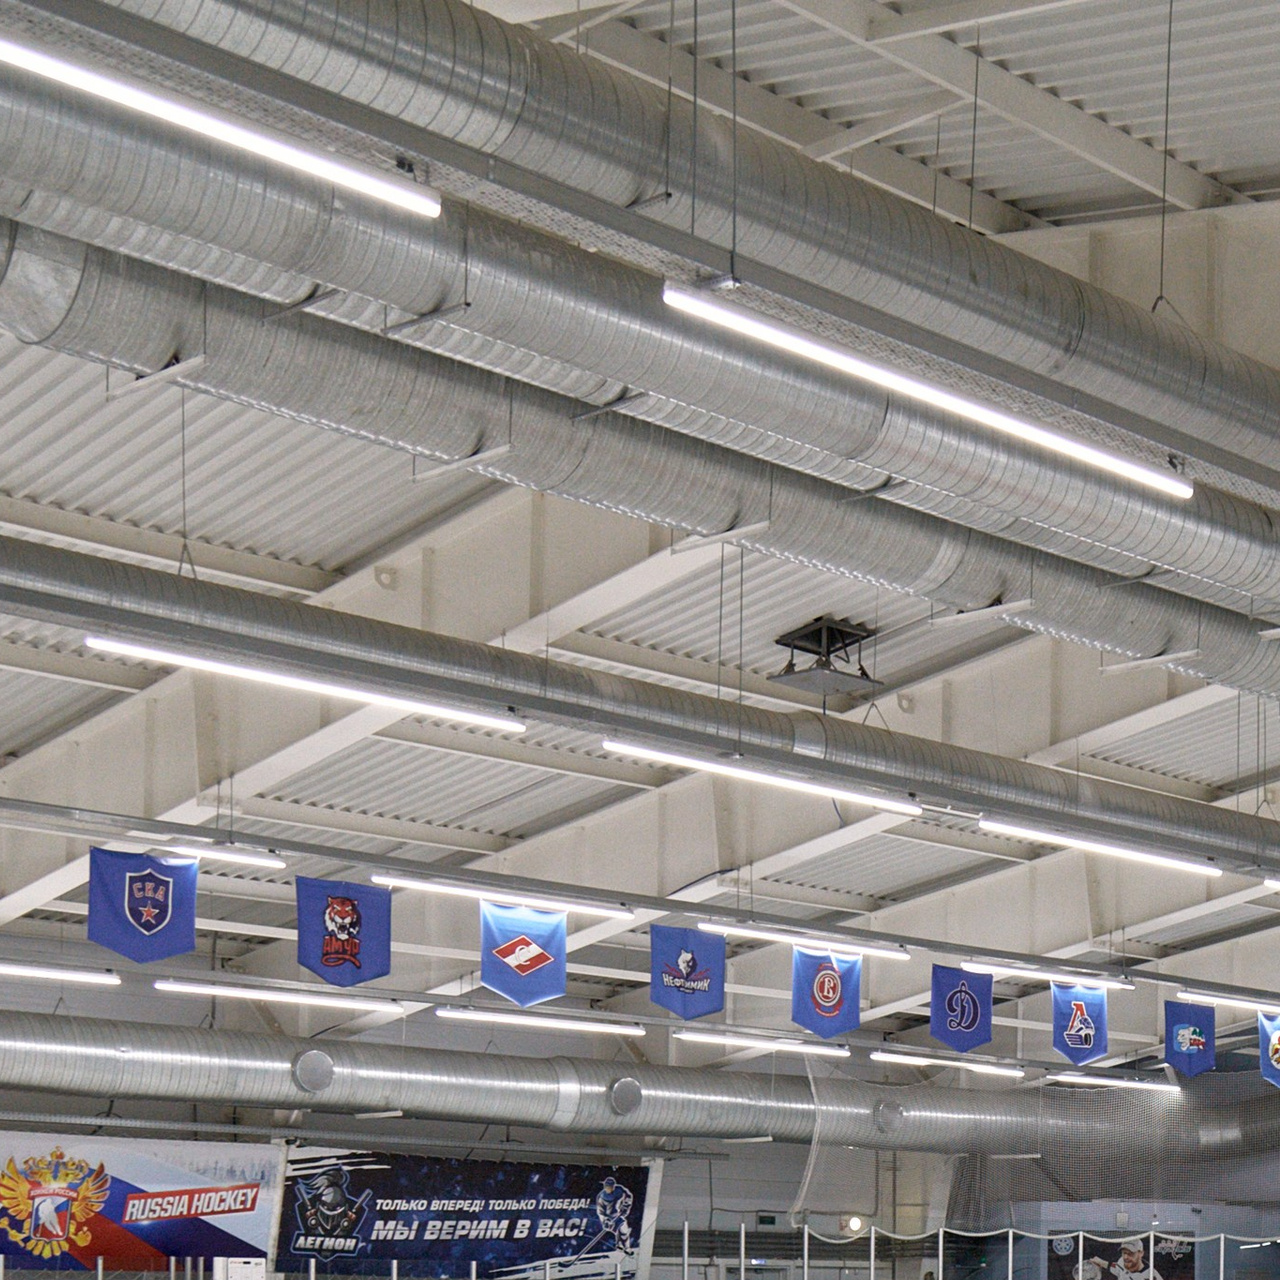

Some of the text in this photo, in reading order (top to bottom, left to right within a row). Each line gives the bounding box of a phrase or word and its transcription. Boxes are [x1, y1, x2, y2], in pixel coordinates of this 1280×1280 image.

[131, 881, 166, 903] СКА
[322, 934, 362, 955] АМУР
[125, 1190, 258, 1222] RUSSIA HOCKEY
[375, 1198, 591, 1213] ТОЛЬКО ВПЕРЕД! ТОЛЬКО ПОБЕДА!
[370, 1218, 588, 1241] МЫ ВЕРИМ В ВАС!
[294, 1236, 357, 1251] ЛЕГИОН
